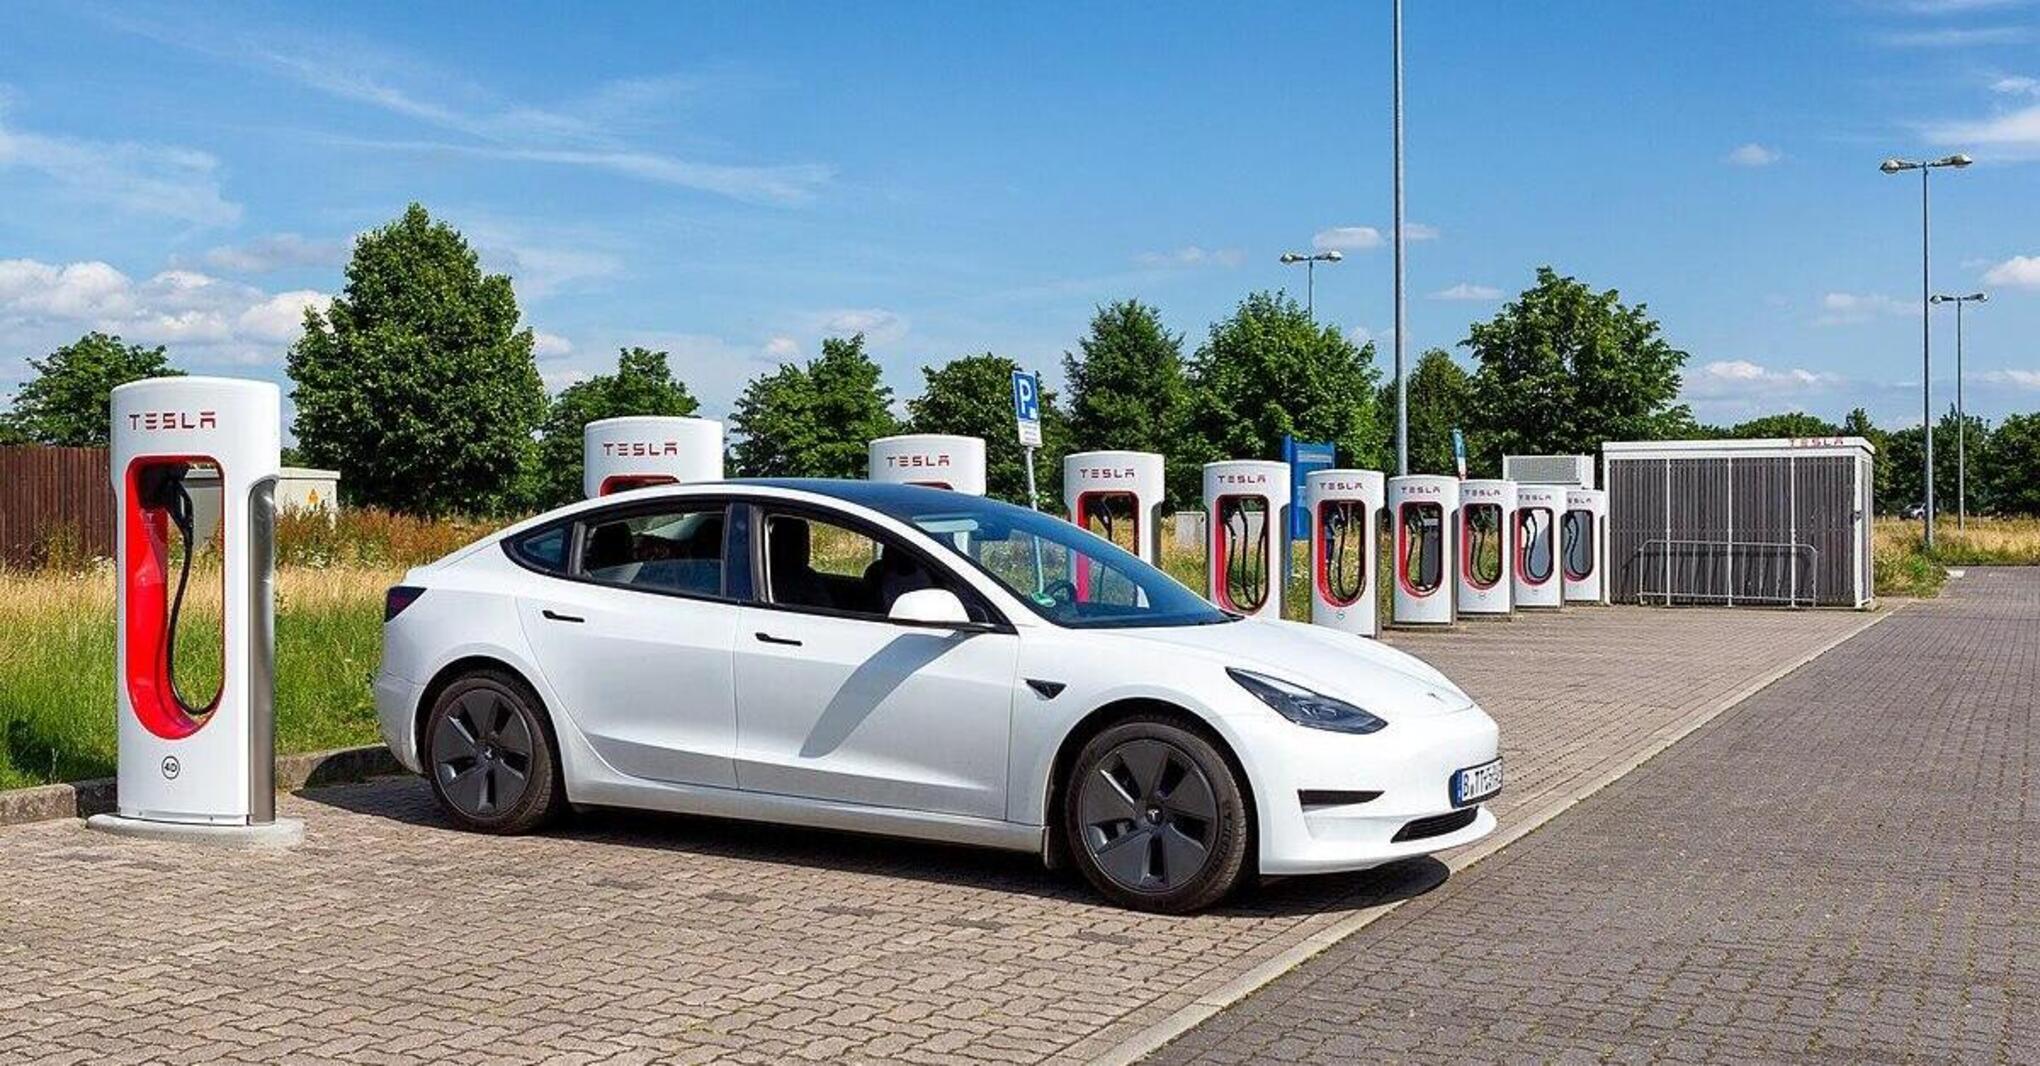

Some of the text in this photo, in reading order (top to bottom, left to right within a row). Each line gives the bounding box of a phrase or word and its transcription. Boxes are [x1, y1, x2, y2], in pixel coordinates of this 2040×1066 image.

[1018, 379, 1032, 415] P
[129, 411, 216, 430] TESLA
[603, 442, 677, 456] TESLA
[886, 455, 950, 467] TESLA
[1080, 468, 1135, 478] TESLA
[1218, 475, 1266, 483] TESLA
[1320, 482, 1363, 491] TESLA
[1401, 486, 1441, 495] TESLA
